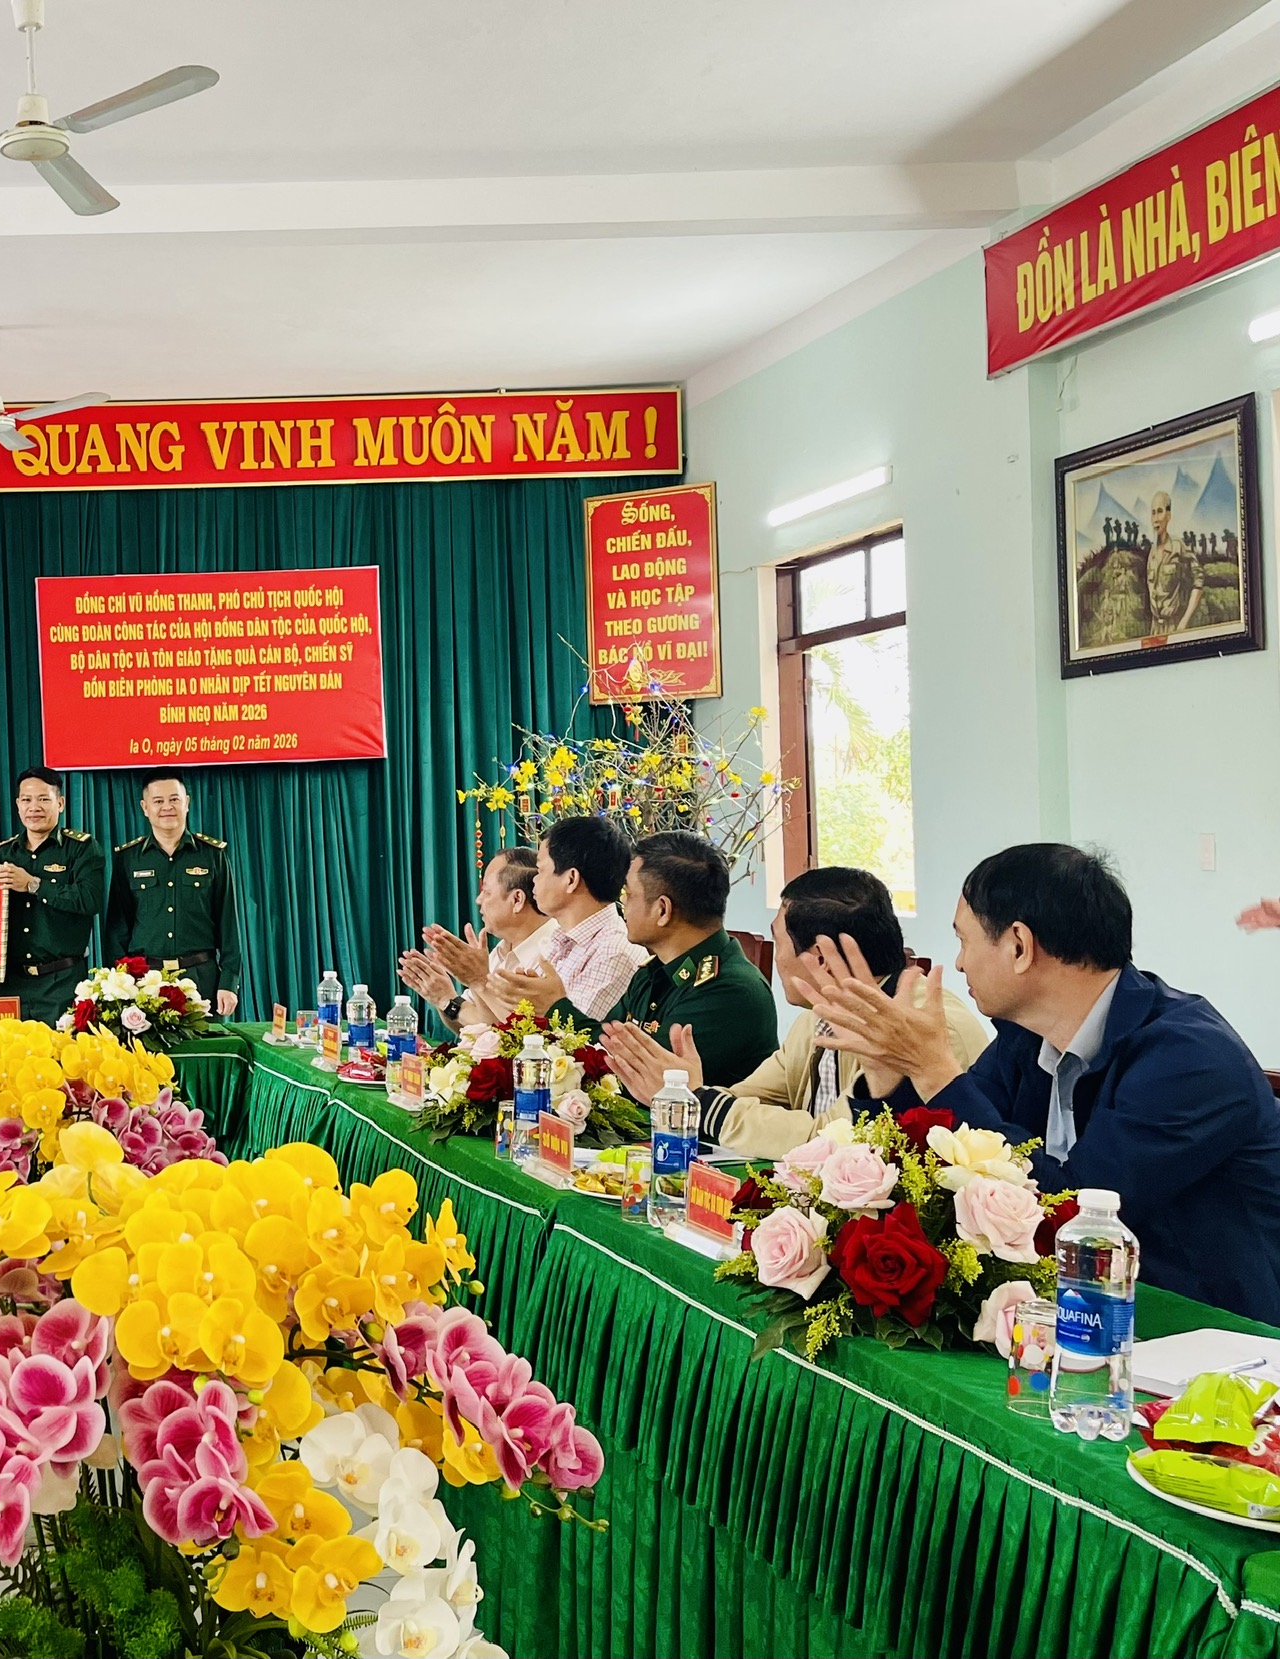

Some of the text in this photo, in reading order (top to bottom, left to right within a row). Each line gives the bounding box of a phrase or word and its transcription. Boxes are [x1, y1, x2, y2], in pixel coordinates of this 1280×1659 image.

[1017, 226, 1075, 333] ĐỒN
[1080, 204, 1117, 304] LÀ
[1122, 164, 1200, 284] NHÀ,
[12, 421, 185, 477] QUANG
[201, 418, 336, 470] VINH
[353, 402, 496, 467] MUÔN
[512, 401, 630, 463] NĂM
[621, 500, 675, 525] SỐNG,
[606, 525, 692, 553] CHIẾN ĐẤU,
[612, 557, 687, 580] LAO ĐỘNG
[108, 592, 126, 613] CHÍ
[129, 592, 142, 612] VŨ
[178, 593, 216, 612] THANH,
[218, 589, 240, 609] PHÓ
[243, 586, 265, 609] CHỦ
[267, 590, 291, 611] TỊCH
[294, 584, 322, 608] QUỐC
[325, 586, 343, 609] HỘI
[607, 583, 695, 609] VÀ HỌC TẬP
[50, 623, 80, 643] CÙNG
[82, 622, 112, 642] ĐOÀN
[114, 621, 144, 640] CÔNG
[146, 620, 167, 640] TÁC
[170, 617, 191, 639] CỦA
[194, 619, 212, 641] HỘI
[247, 617, 269, 637] DÂN
[272, 616, 292, 639] TỘC
[295, 613, 317, 635] CỦA
[319, 612, 348, 636] QUỐC
[351, 613, 372, 636] HỘI,
[605, 613, 699, 637] THEO GƯƠNG
[71, 641, 353, 673] BỘ DÂN TỘC VÀ TÔN GIÁO TẶNG QUÀ CÁN BỘ, CHIẾN SỸ
[598, 644, 629, 665] BÁC
[658, 641, 672, 661] VĨ
[676, 641, 708, 662] ĐẠI!
[109, 677, 134, 697] BIÊN
[137, 675, 173, 697] PHÒNG
[176, 678, 187, 695] IA
[190, 678, 197, 695] O
[200, 674, 230, 694] NHÂN
[232, 674, 250, 696] DỊP
[254, 670, 271, 692] TẾT
[275, 671, 317, 692] NGUYÊN
[320, 670, 342, 689] ĐÁN
[160, 702, 268, 725] BÍNH NGỌ NĂM 2026
[142, 738, 153, 756] O,
[156, 738, 182, 757] ngày
[185, 737, 198, 752] 05
[200, 736, 230, 754] tháng
[232, 735, 245, 750] 02
[248, 736, 270, 750] năm
[273, 733, 298, 749] 2026
